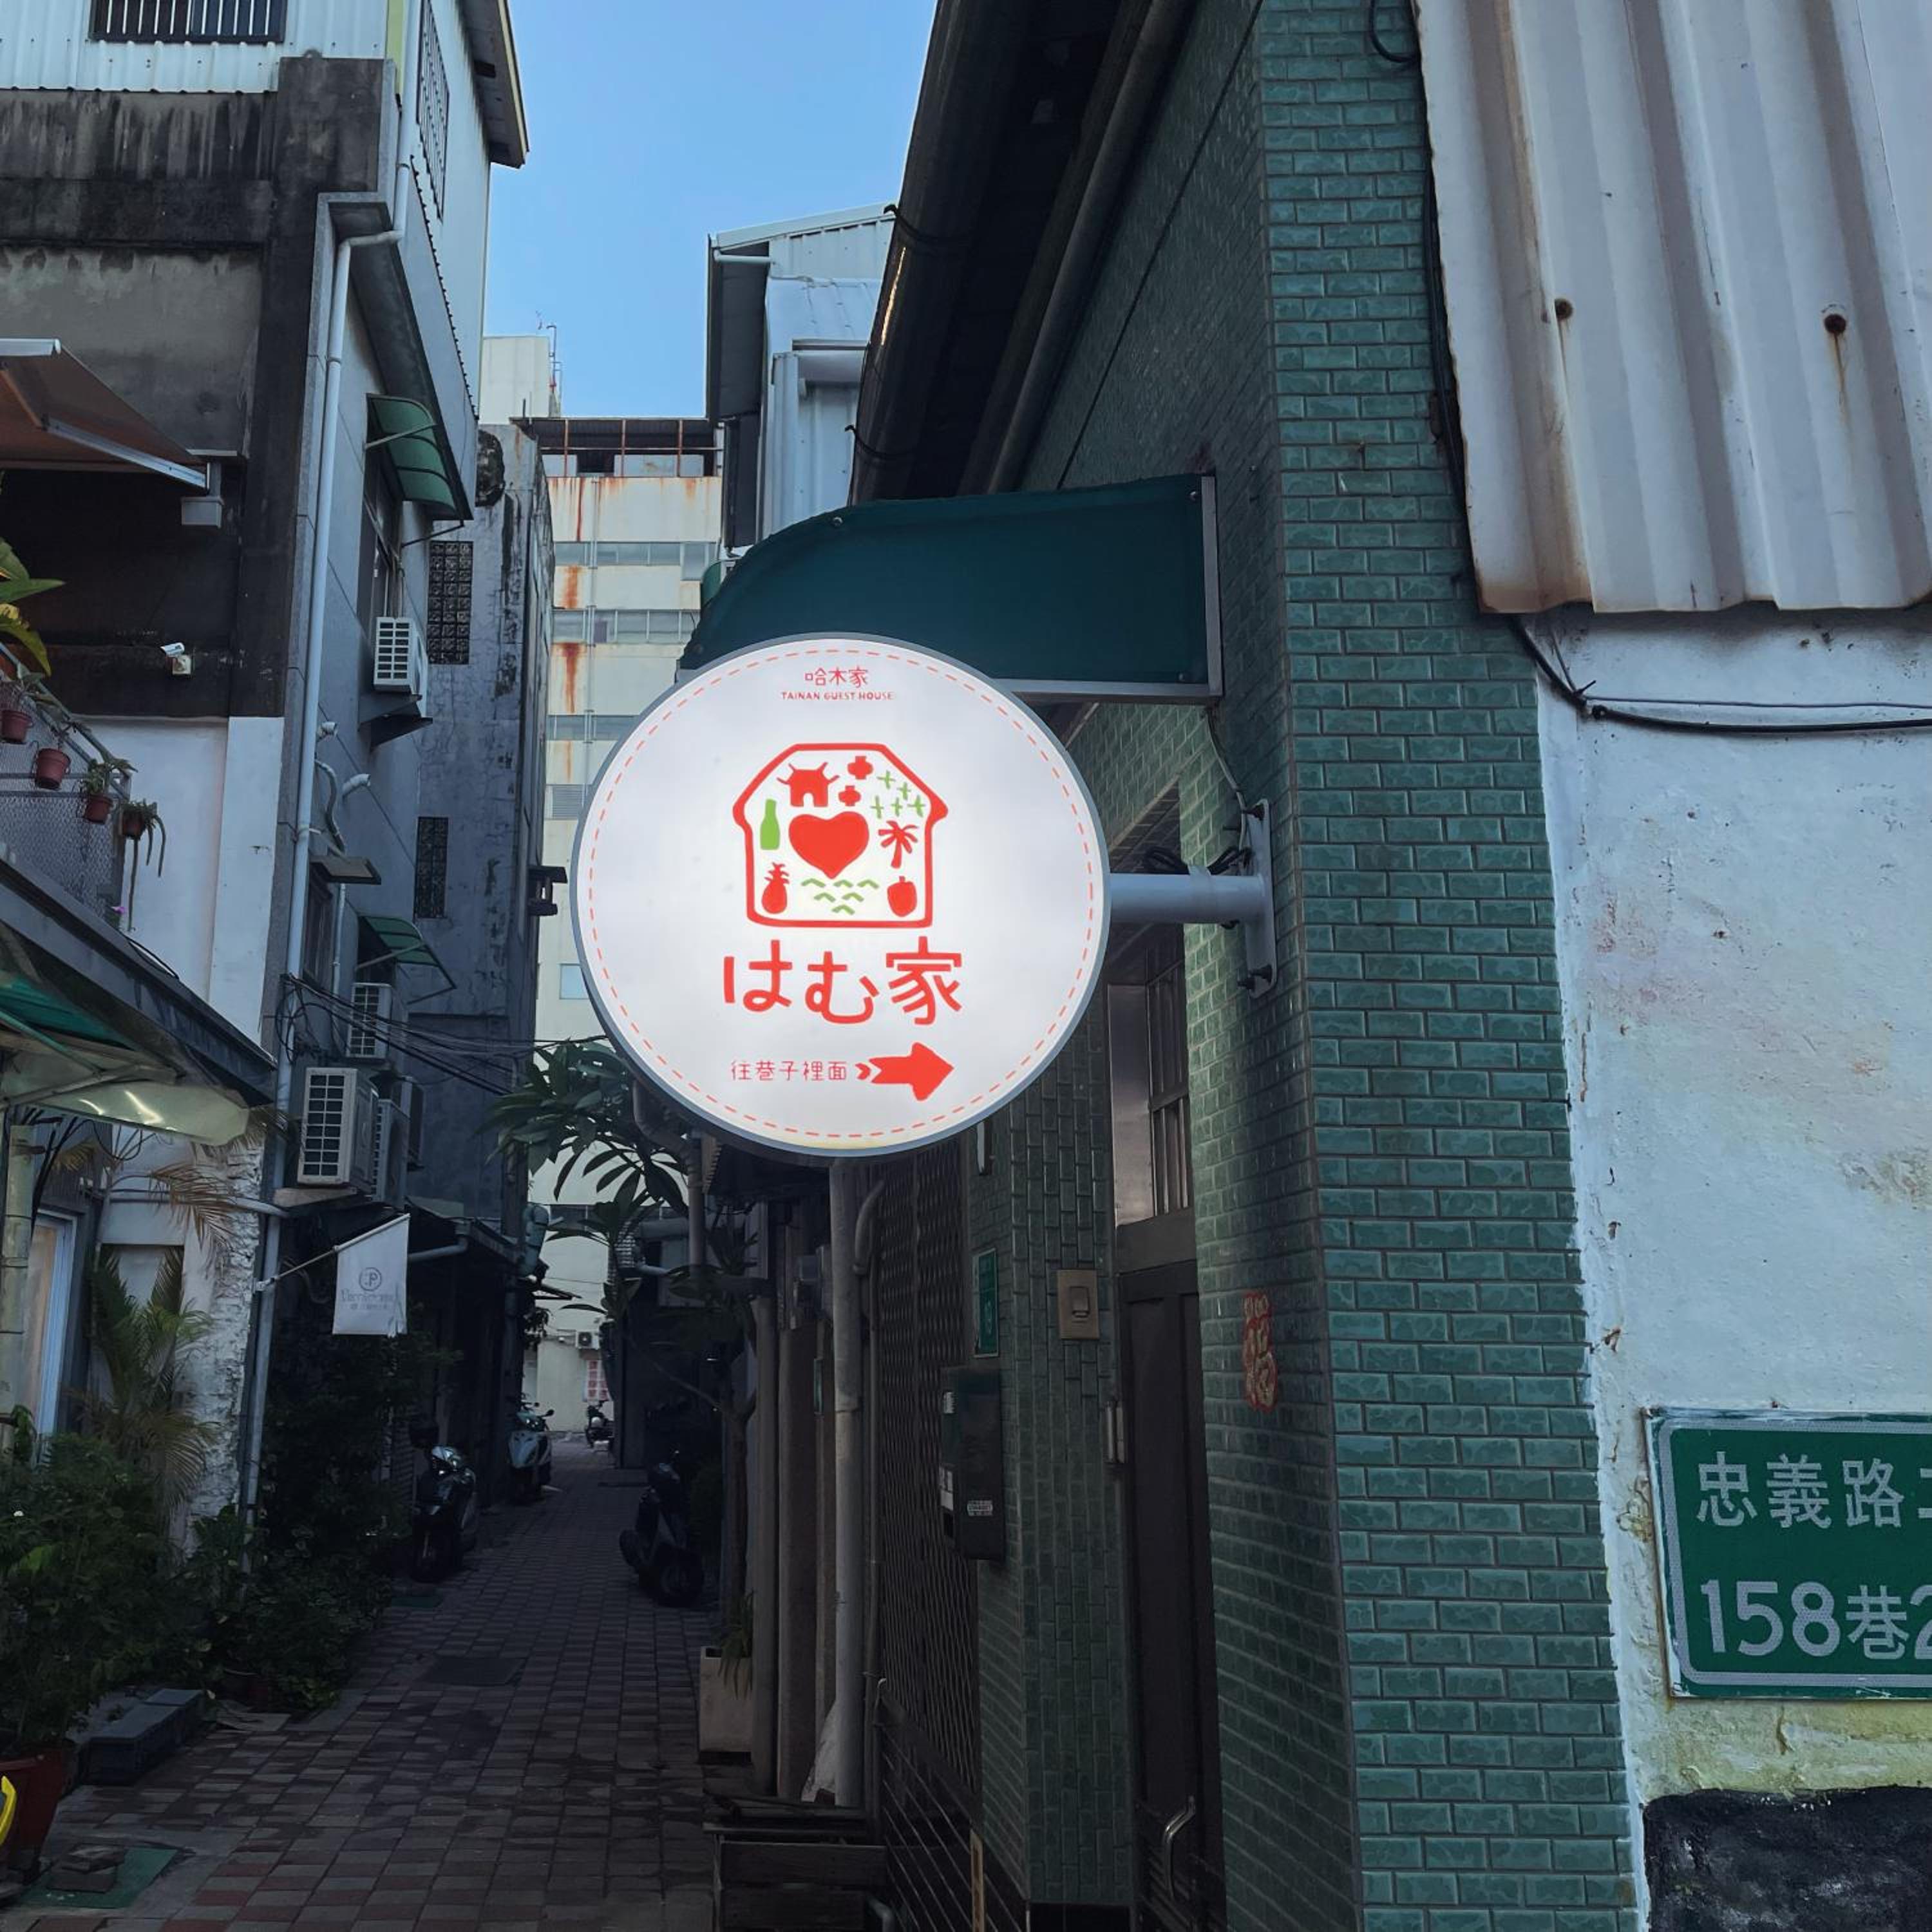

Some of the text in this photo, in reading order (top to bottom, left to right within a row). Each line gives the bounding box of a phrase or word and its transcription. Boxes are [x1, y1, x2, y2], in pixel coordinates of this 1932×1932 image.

[804, 665, 868, 688] 哈木家
[782, 692, 893, 700] TAINAN GUEST HOUSE
[723, 936, 962, 1025] はむ家
[731, 1059, 848, 1081] 往巷子裡面
[1697, 1451, 1932, 1529] 忠義路
